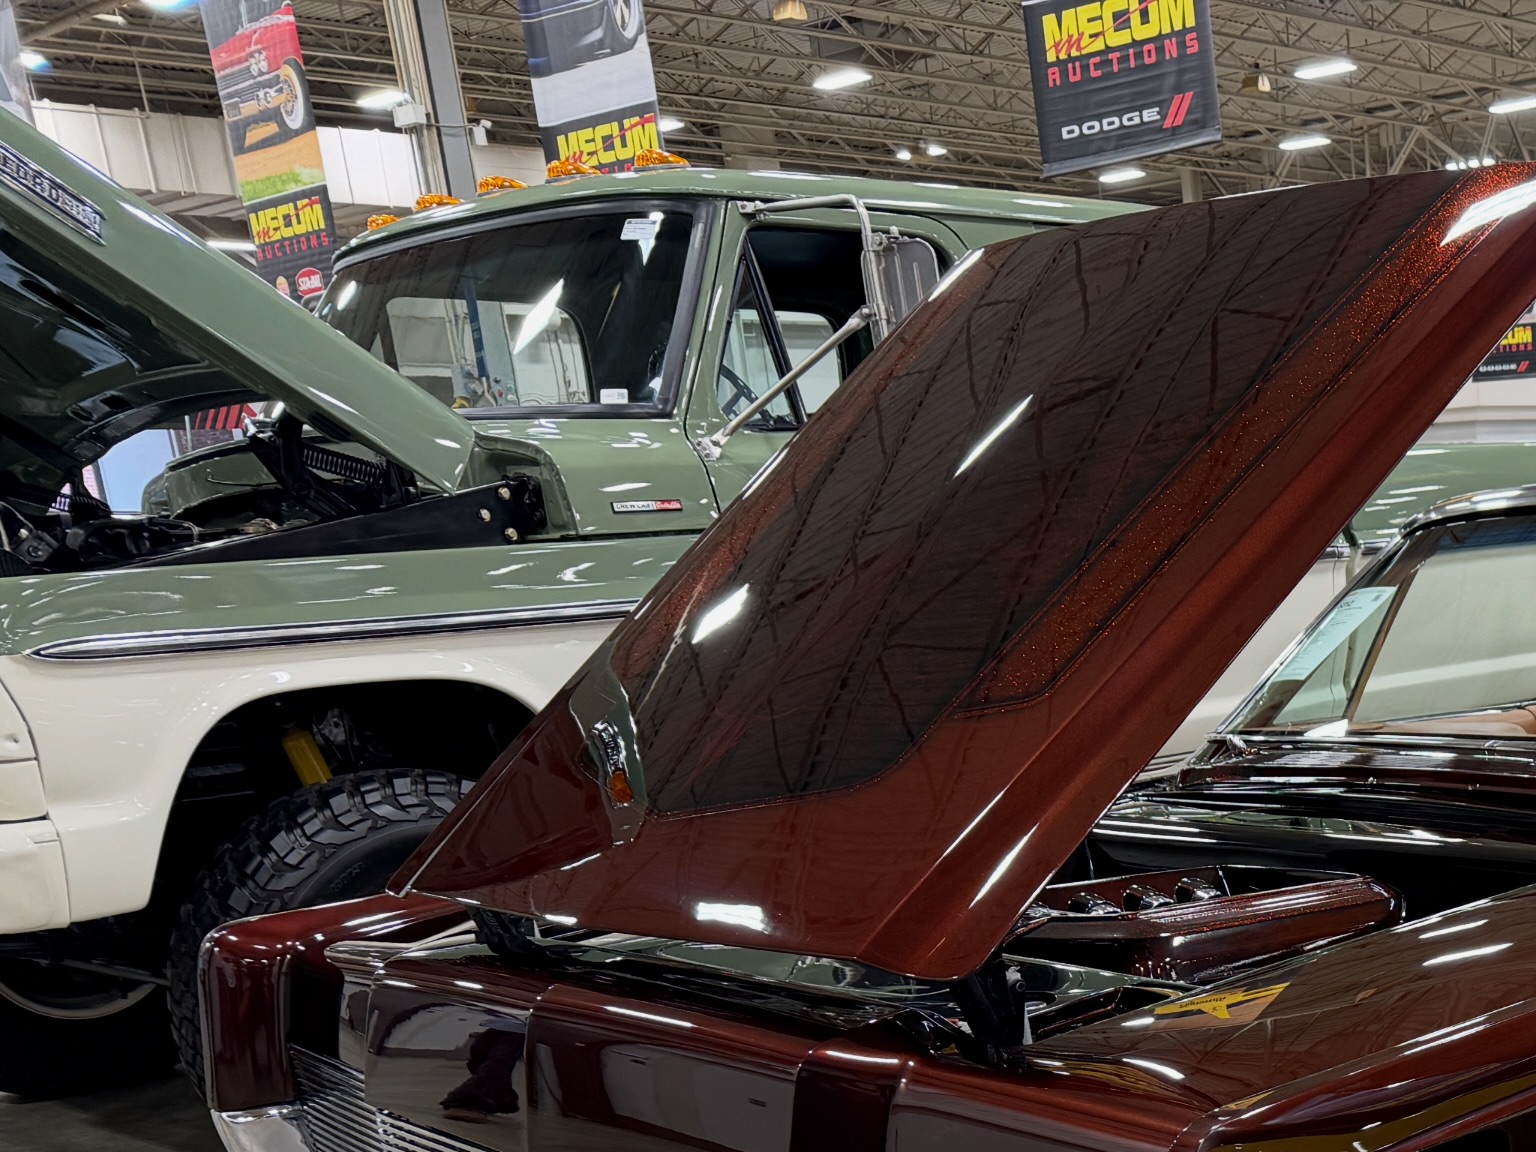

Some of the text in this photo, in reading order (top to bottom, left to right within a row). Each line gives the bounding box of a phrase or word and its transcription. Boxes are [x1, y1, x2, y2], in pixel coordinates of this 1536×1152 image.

[1041, 0, 1196, 63] MECUM
[1047, 32, 1199, 87] AUCTIONS
[557, 112, 660, 167] MECUM
[1061, 107, 1161, 140] DODGE
[248, 195, 326, 246] MECUM
[256, 231, 329, 261] AUCTIONS
